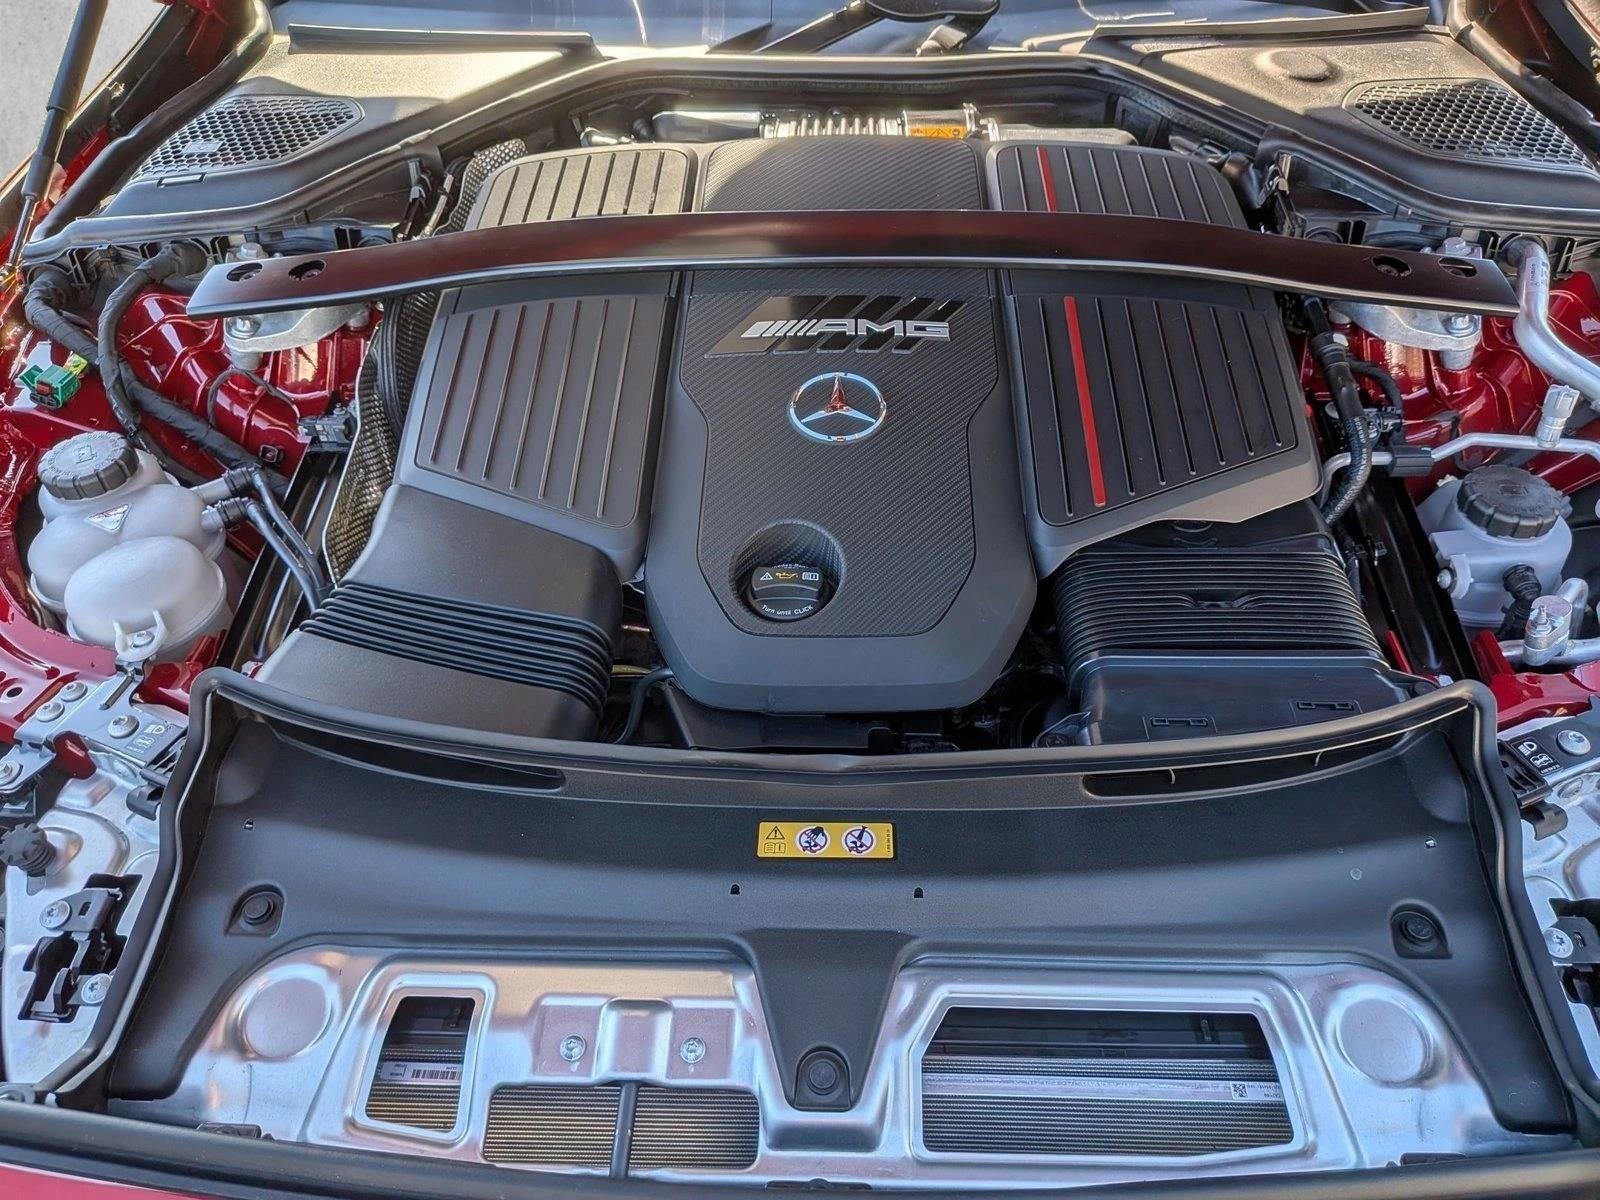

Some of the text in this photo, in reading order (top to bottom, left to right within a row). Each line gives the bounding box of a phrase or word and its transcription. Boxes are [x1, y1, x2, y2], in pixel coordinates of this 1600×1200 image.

[806, 318, 950, 339] AMG
[761, 604, 775, 614] Turn
[793, 604, 814, 615] CLICK
